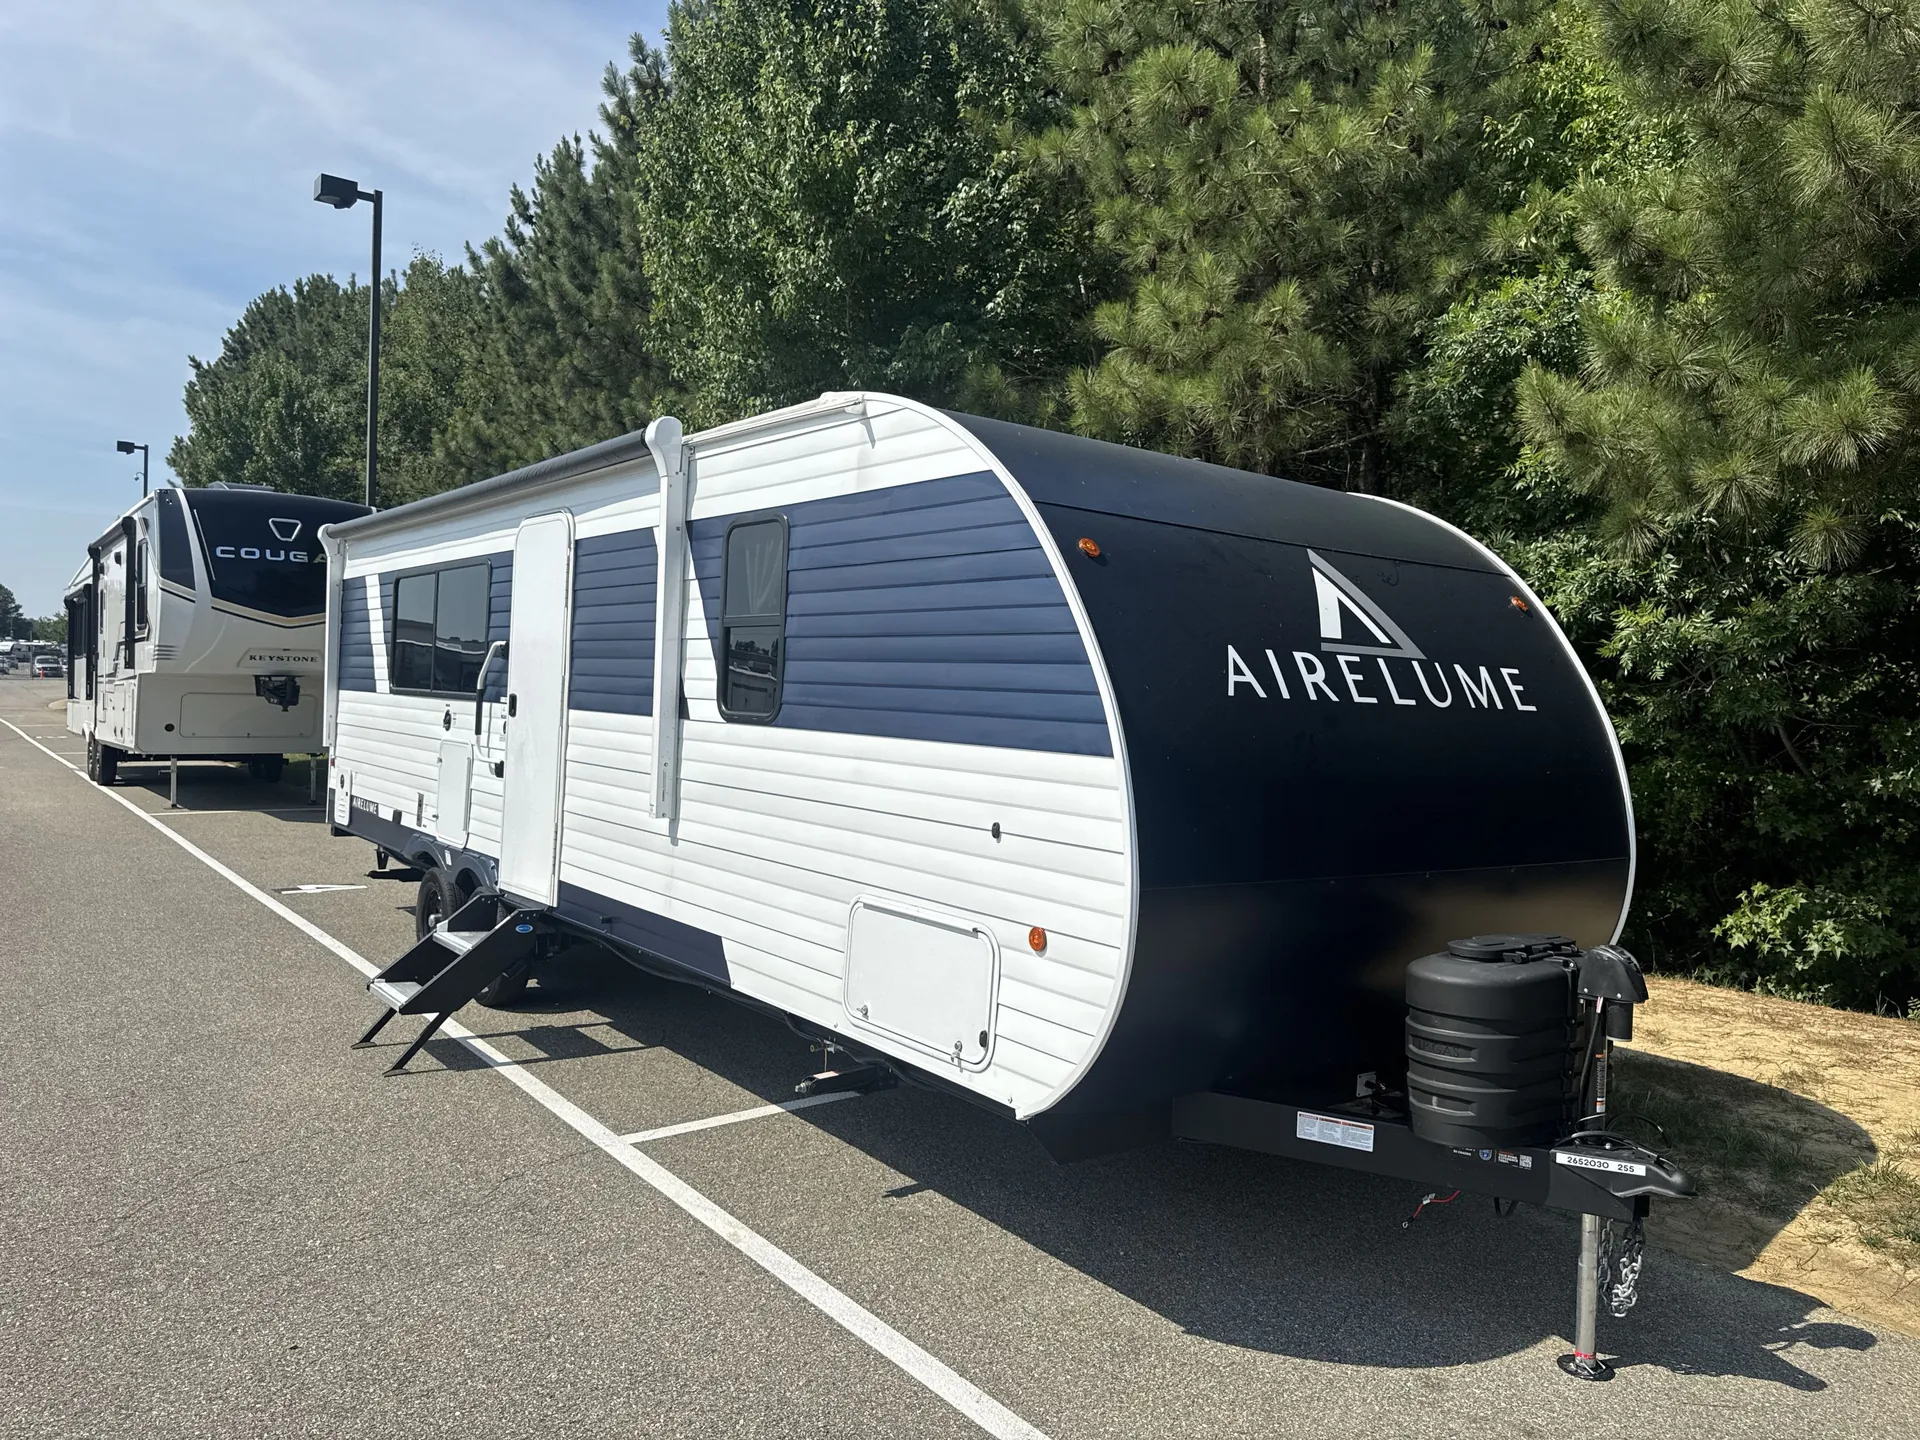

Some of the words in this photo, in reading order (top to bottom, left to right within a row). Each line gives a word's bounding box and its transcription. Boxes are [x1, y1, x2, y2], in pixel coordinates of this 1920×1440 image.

[249, 654, 319, 663] KEYSTONE
[1227, 644, 1538, 712] AIRELUME
[352, 796, 378, 815] AIRELUME
[1567, 1156, 1610, 1169] 2652030
[1617, 1163, 1635, 1173] 255
